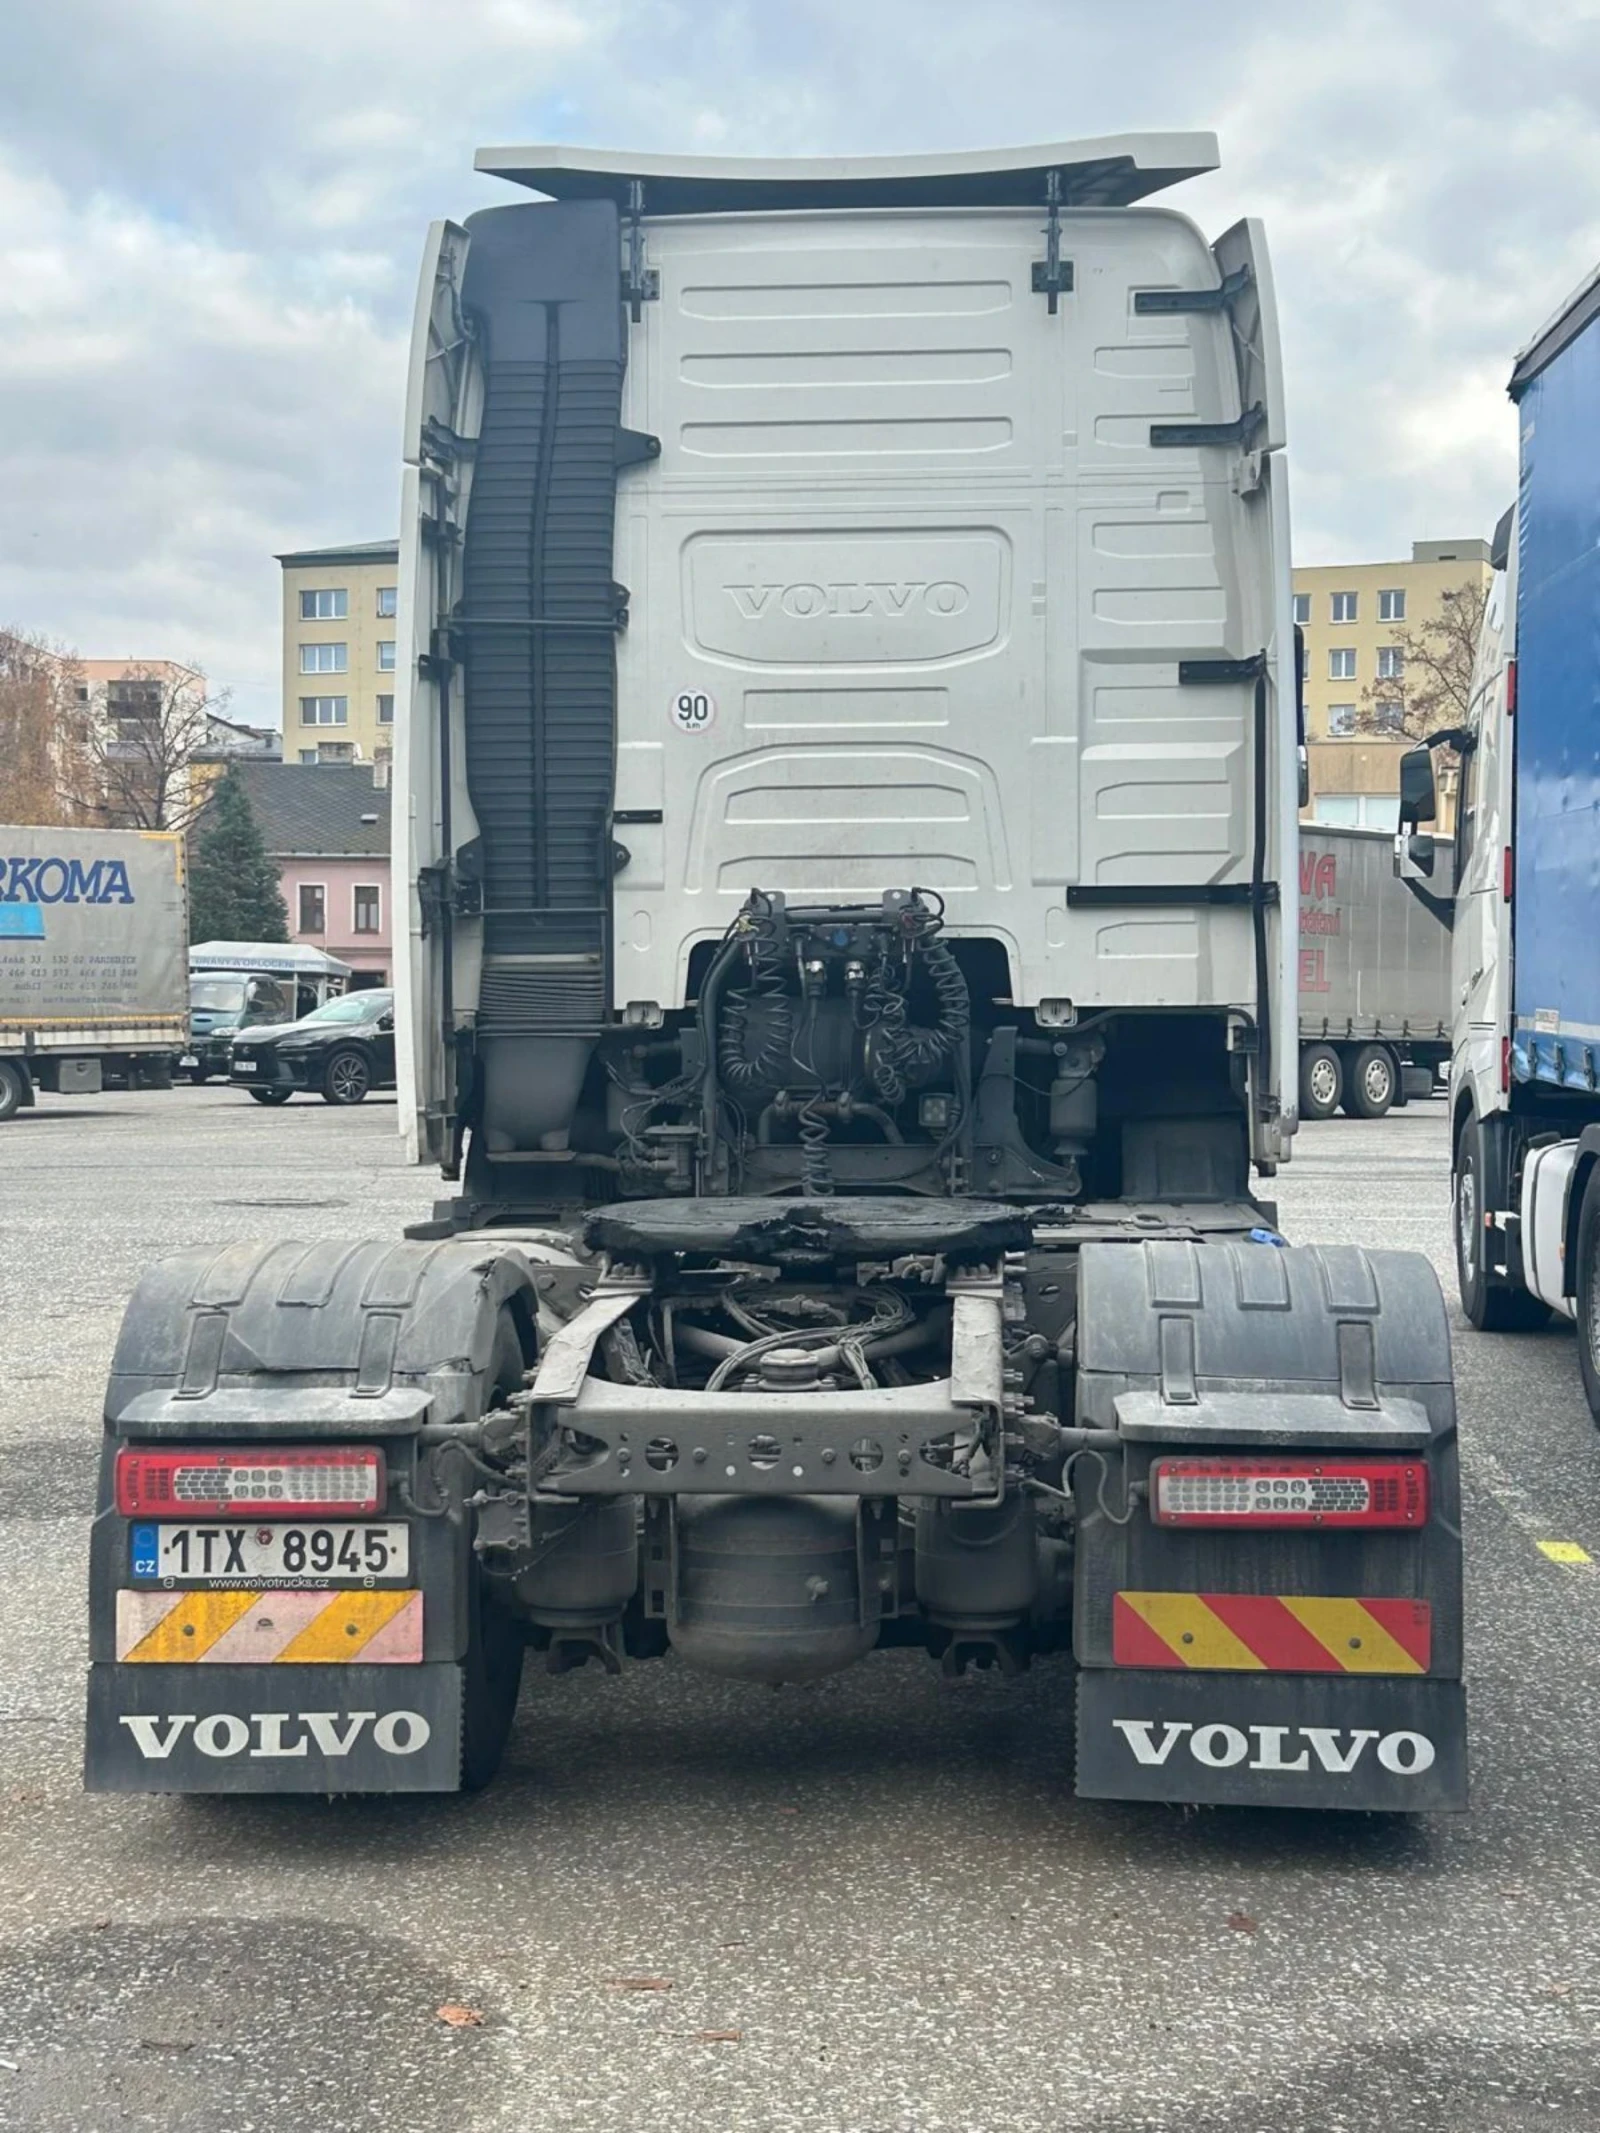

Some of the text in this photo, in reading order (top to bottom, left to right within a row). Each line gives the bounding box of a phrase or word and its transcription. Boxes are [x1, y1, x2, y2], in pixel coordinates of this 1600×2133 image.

[722, 581, 969, 619] VOLVO
[678, 695, 708, 721] 90
[0, 857, 135, 904] KOMA
[135, 1559, 156, 1573] CZ
[171, 1528, 388, 1573] 1TX 8945
[209, 1576, 330, 1589] www.volvotrucks.cz
[119, 1710, 430, 1758] VOLVO
[1112, 1719, 1436, 1775] VOLVO
